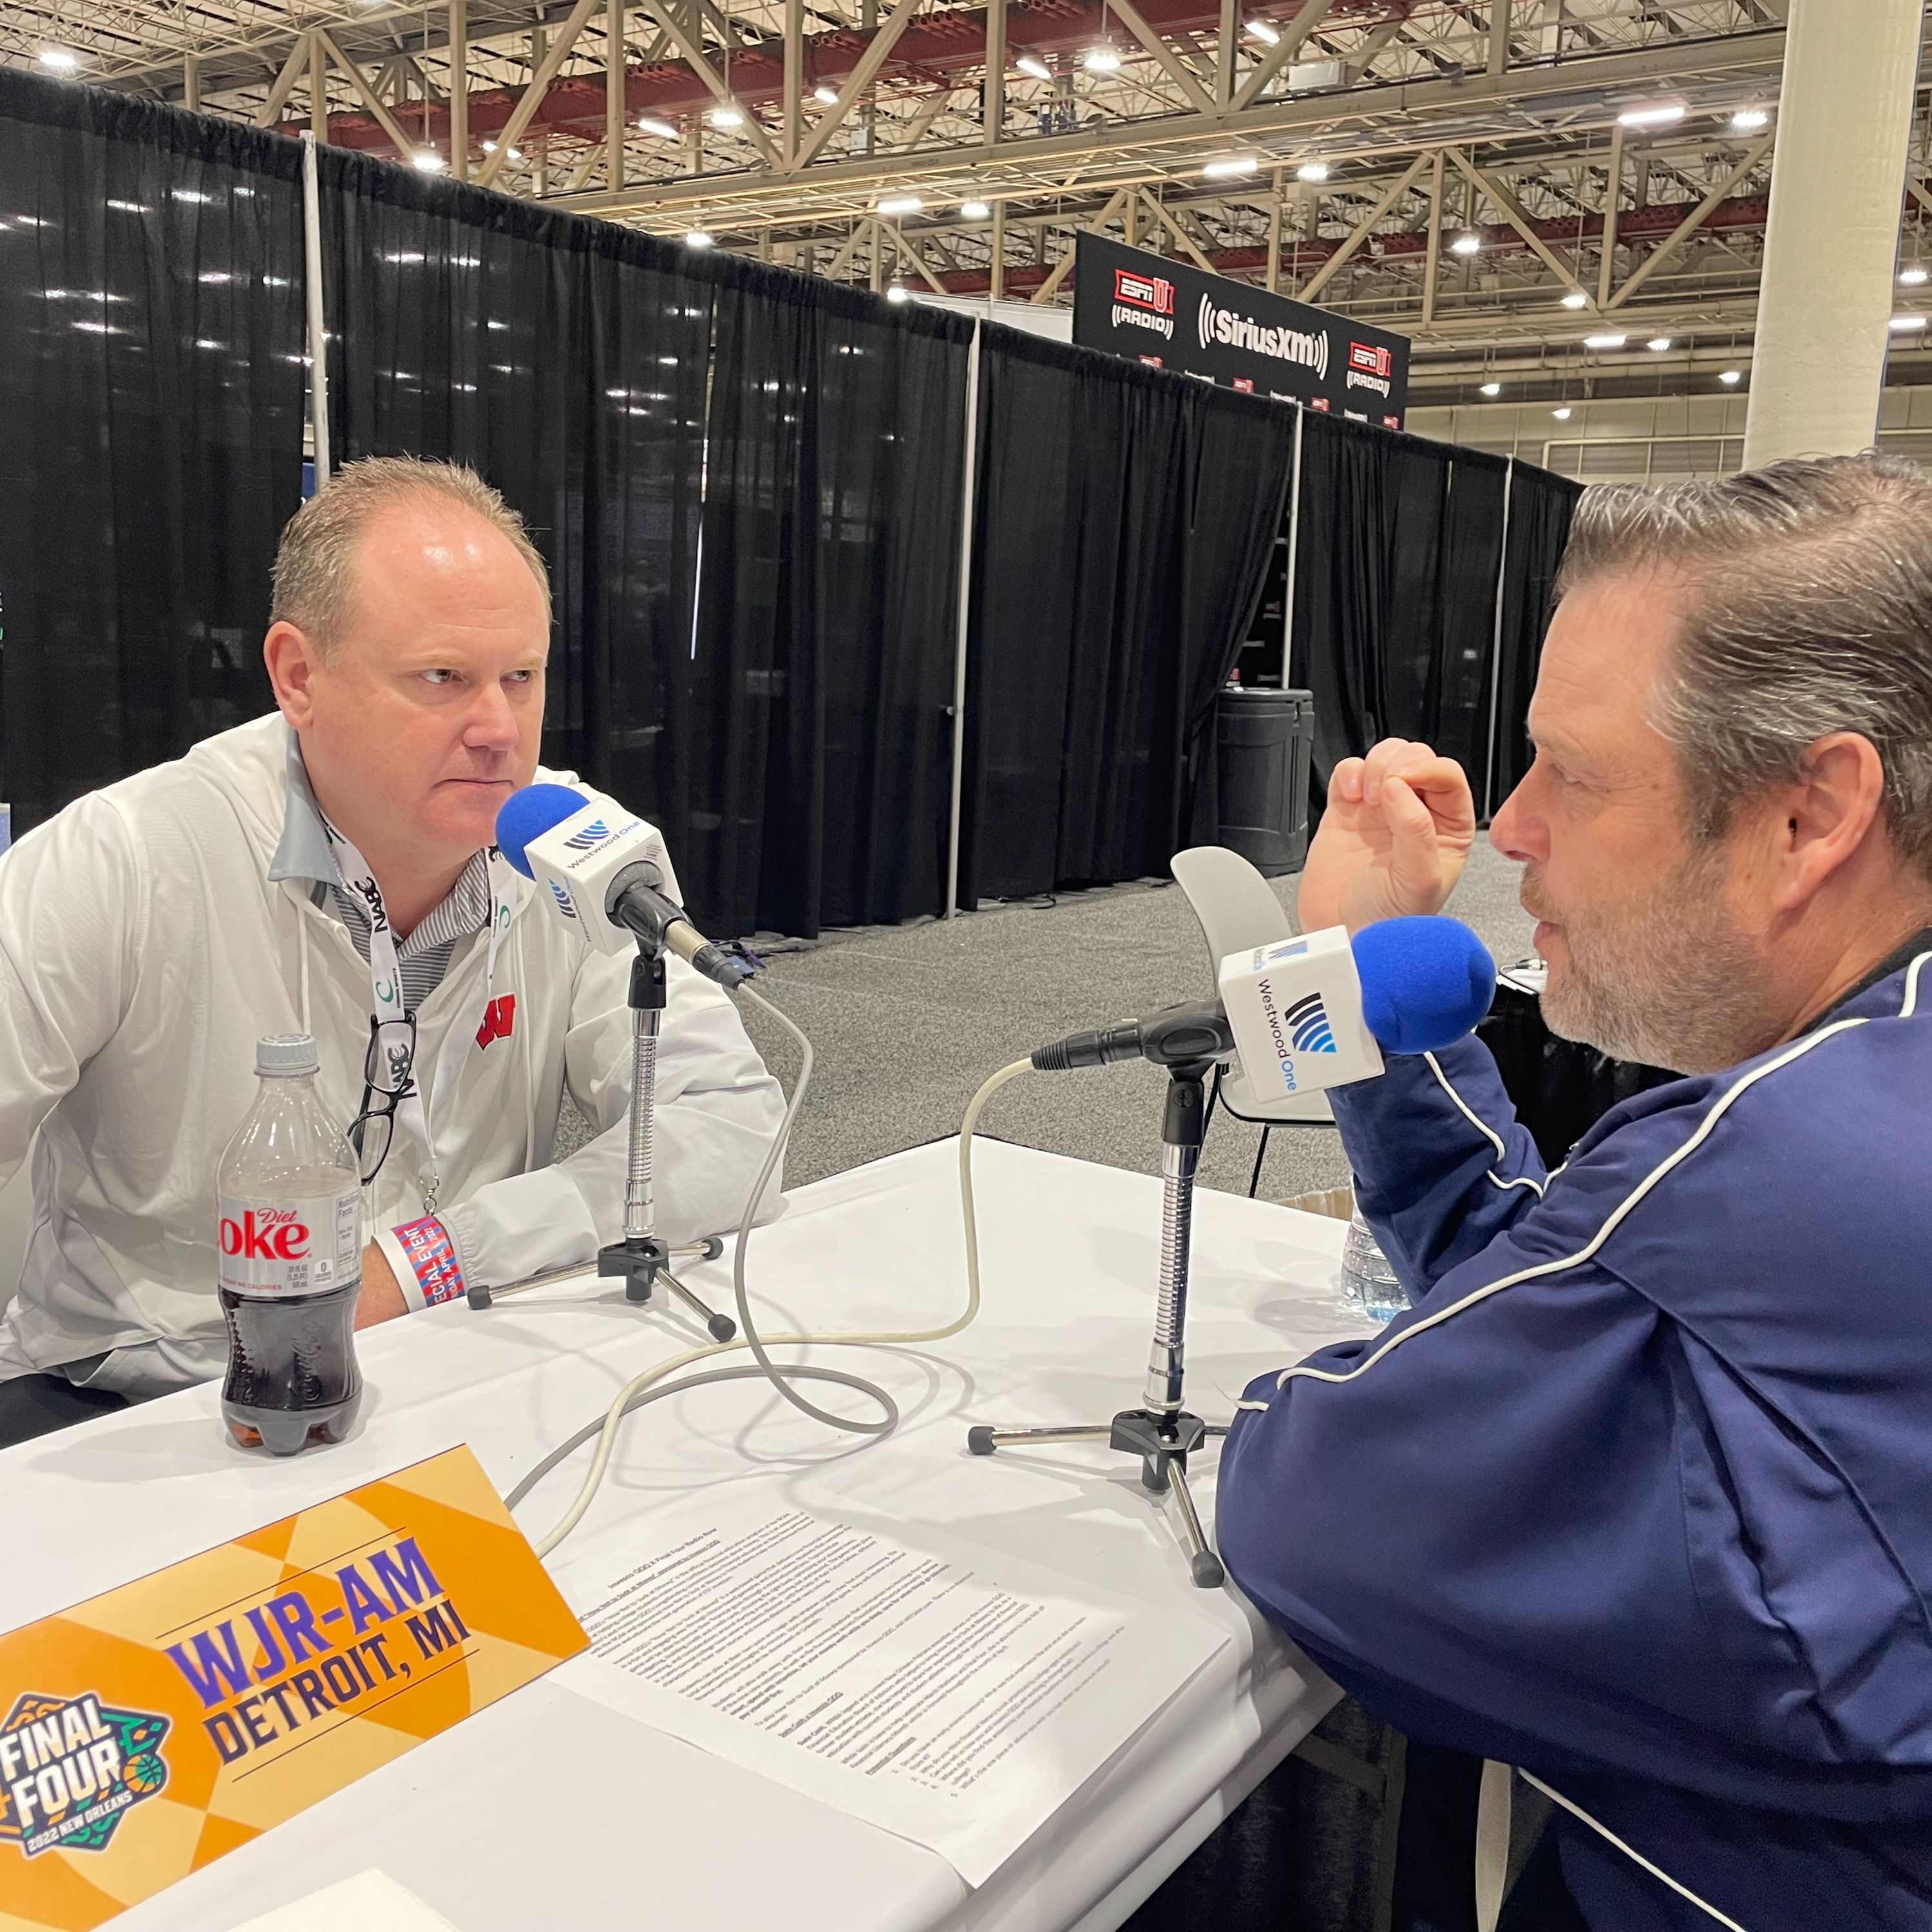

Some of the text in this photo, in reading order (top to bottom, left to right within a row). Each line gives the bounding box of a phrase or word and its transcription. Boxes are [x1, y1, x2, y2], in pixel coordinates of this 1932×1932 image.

[1121, 307, 1165, 332] RADIO
[1353, 373, 1383, 392] RADIO
[567, 833, 620, 869] Westwood
[619, 821, 640, 835] One
[1258, 979, 1291, 1058] Westwood
[1282, 1061, 1296, 1090] One
[219, 1211, 310, 1261] oke
[257, 1208, 297, 1223] Diet
[424, 1227, 438, 1242] 2022
[321, 1262, 326, 1272] 0
[404, 1227, 433, 1262] EVENT
[437, 1248, 452, 1273] APRIL
[162, 1536, 446, 1709] WJR-AM
[202, 1599, 473, 1766] DETROIT, MI
[0, 1698, 111, 1781] FINAL
[11, 1736, 121, 1828] FOUR
[27, 1790, 133, 1853] 2022 NEW ORLEANS
